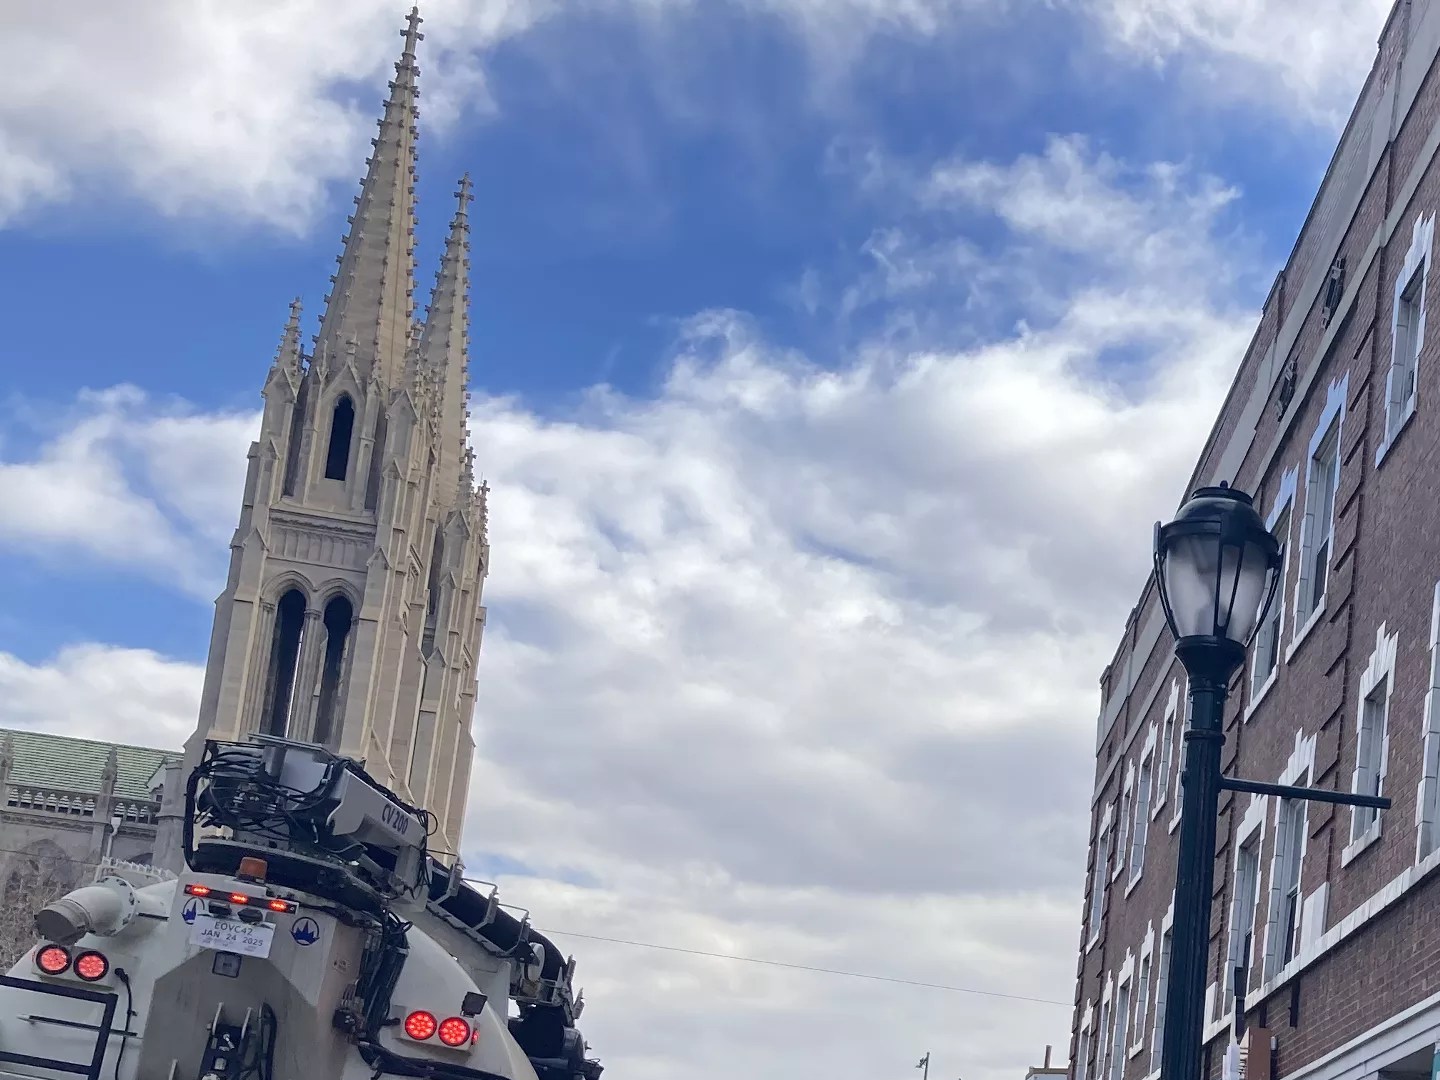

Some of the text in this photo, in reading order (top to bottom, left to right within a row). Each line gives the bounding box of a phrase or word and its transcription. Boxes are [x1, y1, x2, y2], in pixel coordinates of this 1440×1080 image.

[381, 804, 409, 835] CV 200
[201, 928, 221, 938] JAN
[226, 933, 237, 941] 24
[242, 936, 264, 947] 2025
